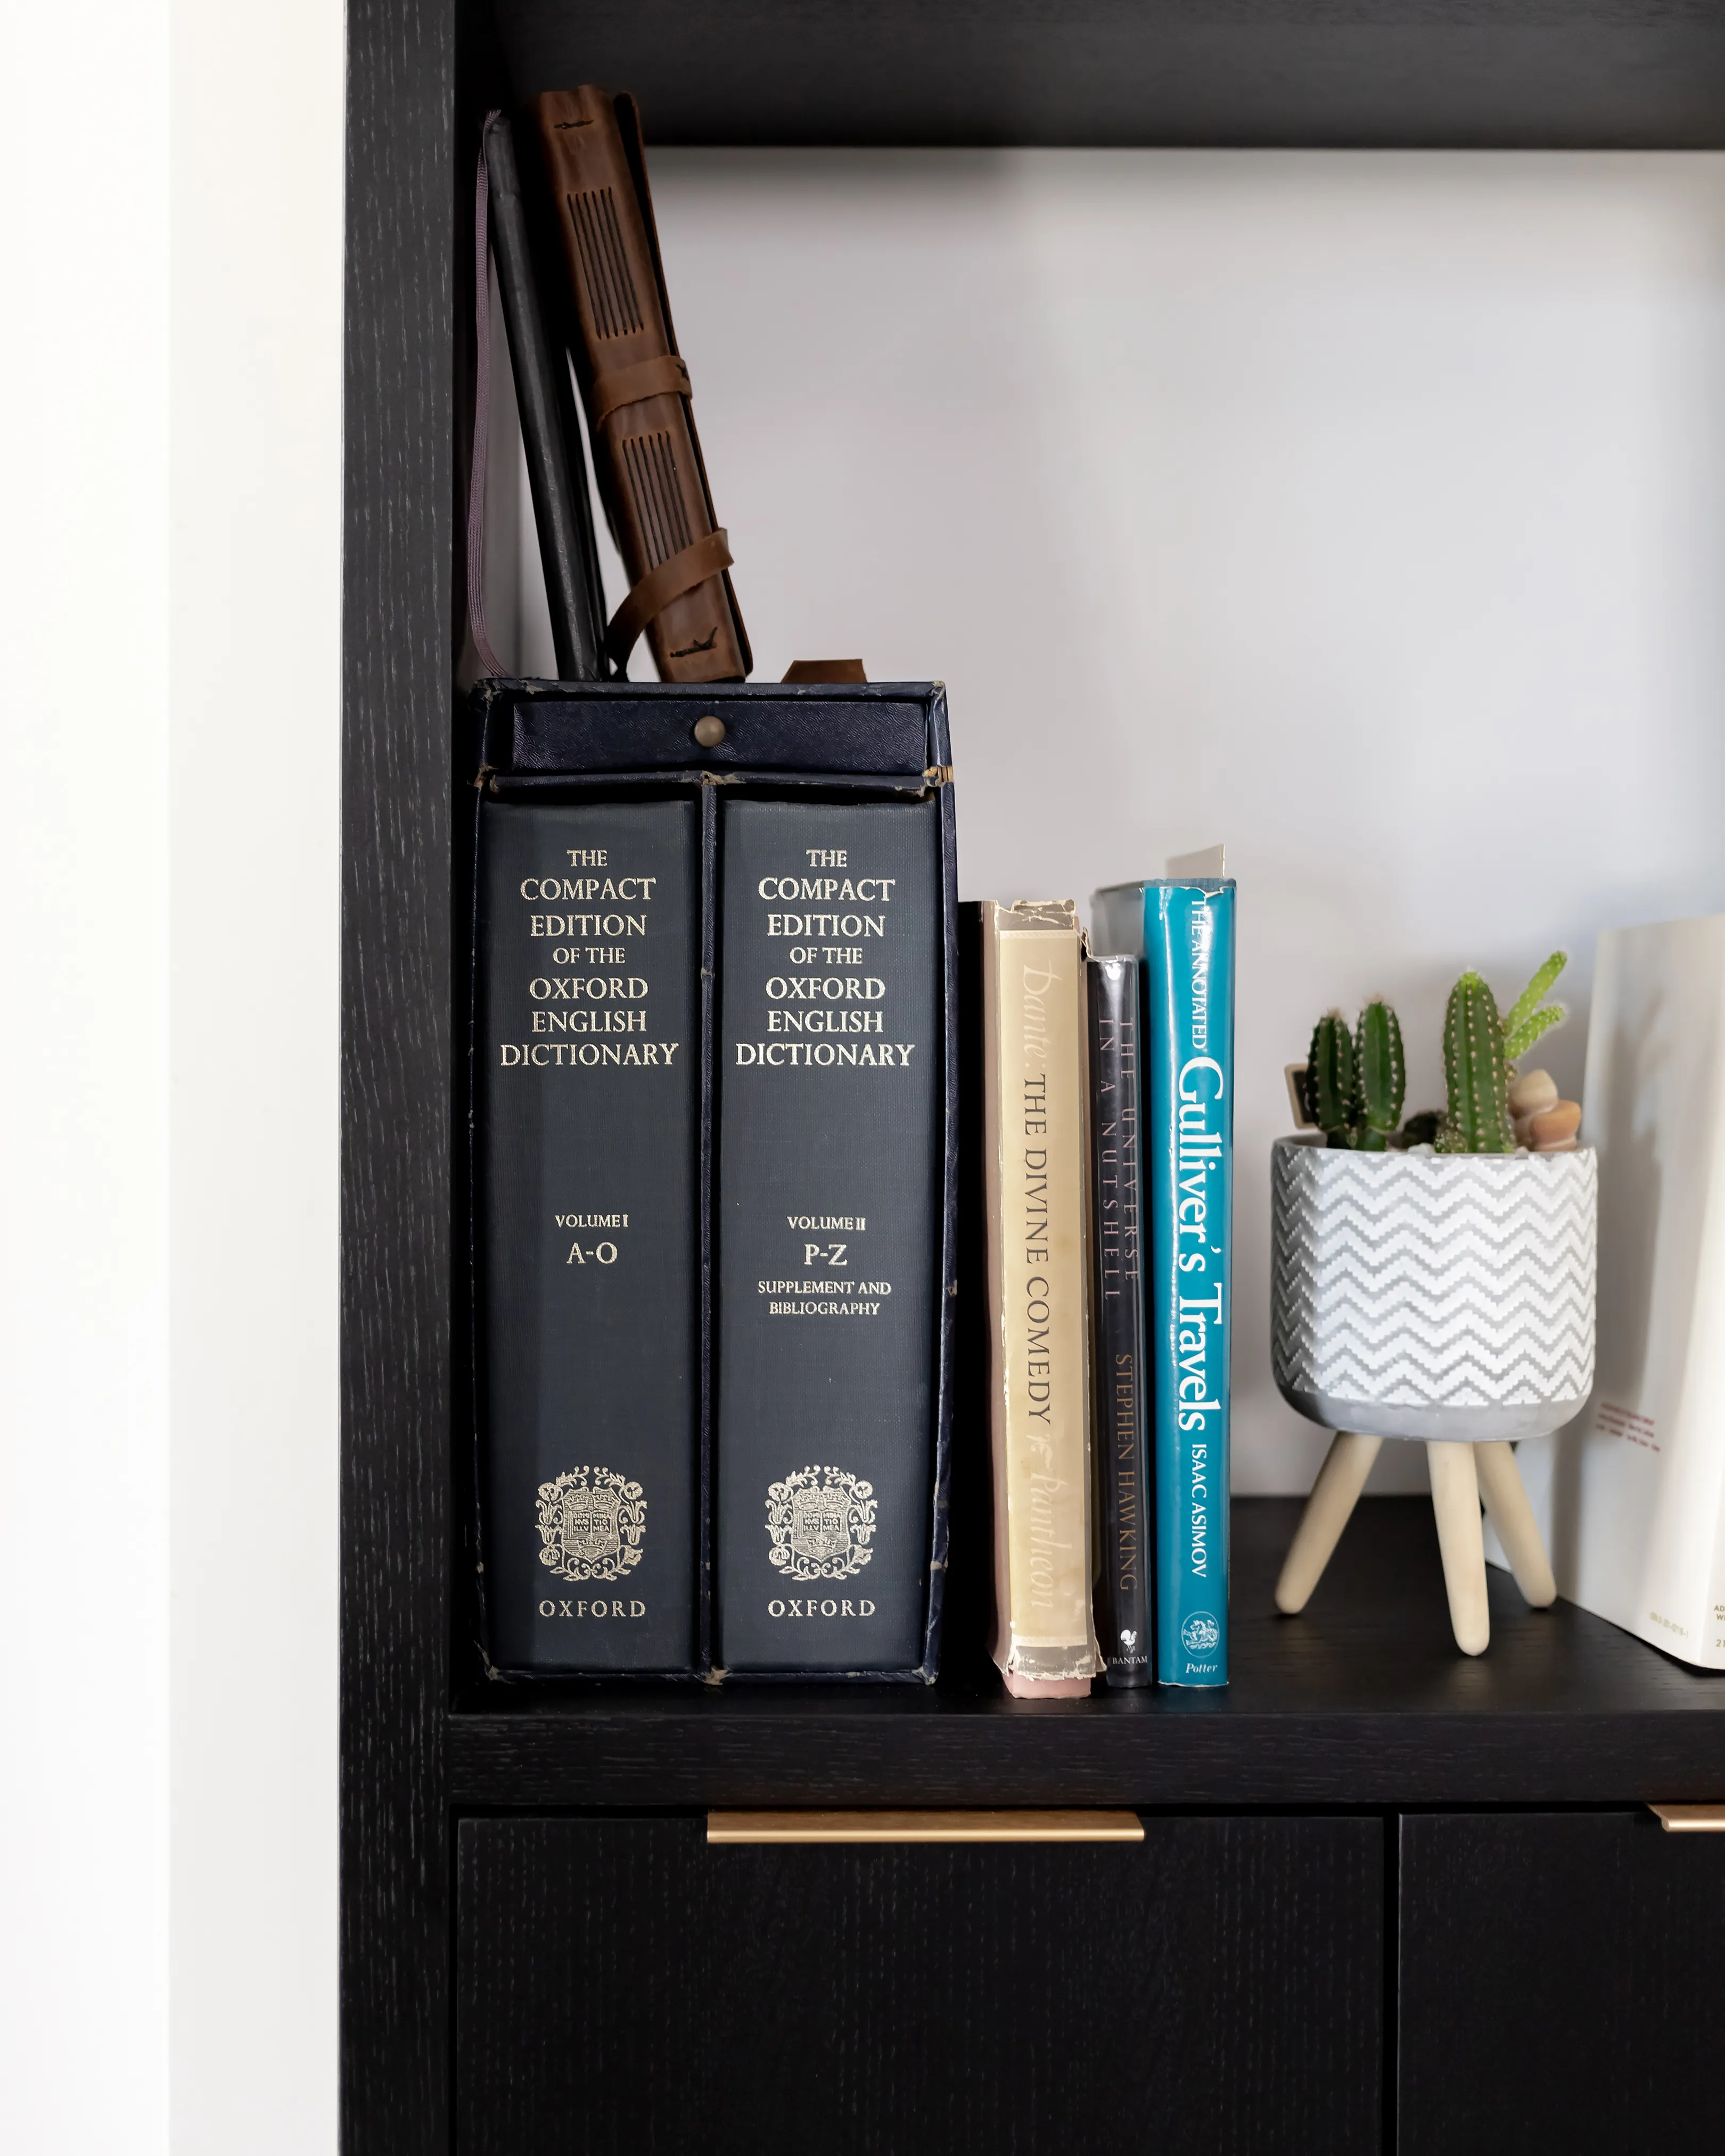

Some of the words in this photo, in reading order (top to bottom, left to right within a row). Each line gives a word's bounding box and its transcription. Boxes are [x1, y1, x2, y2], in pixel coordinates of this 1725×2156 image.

[567, 849, 607, 867] THE
[806, 849, 847, 868] THE
[520, 877, 656, 901] COMPACT
[758, 877, 895, 901] COMPACT
[530, 914, 647, 936] EDITION
[767, 914, 886, 937] EDITION
[1192, 896, 1207, 935] THE
[553, 947, 580, 964] OF
[585, 947, 626, 964] THE
[790, 947, 817, 964] OF
[822, 947, 862, 964] THE
[529, 977, 648, 1000] OXFORD
[766, 977, 886, 1000] OXFORD
[1192, 940, 1207, 1049] ANNOTATED
[532, 1010, 647, 1032] ENGLISH
[767, 1010, 883, 1033] ENGLISH
[1099, 1019, 1114, 1051] IN
[500, 1043, 679, 1066] DICTIONARY
[736, 1043, 915, 1066] DICTIONARY
[1120, 1017, 1133, 1079] THE
[1100, 1080, 1115, 1093] A
[1024, 1073, 1046, 1135] THE
[1179, 1057, 1223, 1272] Gulliver's
[1121, 1108, 1138, 1280] UNIVERSE
[1024, 1148, 1048, 1264] DIVINE
[1102, 1122, 1120, 1299] NUTSHELL
[555, 1214, 620, 1228] VOLUME
[622, 1214, 629, 1228] I
[787, 1216, 853, 1230] VOLUME
[855, 1217, 866, 1231] II
[566, 1242, 618, 1264] A-O
[804, 1244, 848, 1265] P-Z
[758, 1280, 855, 1294] SUPPLEMENT
[858, 1281, 892, 1295] AND
[769, 1302, 880, 1315] BIBLIOGRAPHY
[1026, 1276, 1050, 1425] COMEDY
[1178, 1282, 1222, 1431] Travels
[1116, 1354, 1134, 1460] STEPHEN
[1192, 1444, 1207, 1499] ISAAC
[1118, 1470, 1138, 1591] HAWKING
[1192, 1502, 1206, 1578] ASIMOV
[539, 1600, 646, 1617] OXFORD
[768, 1599, 876, 1617] OXFORD
[1112, 1656, 1148, 1665] BANTAM
[1185, 1663, 1218, 1674] Potter
